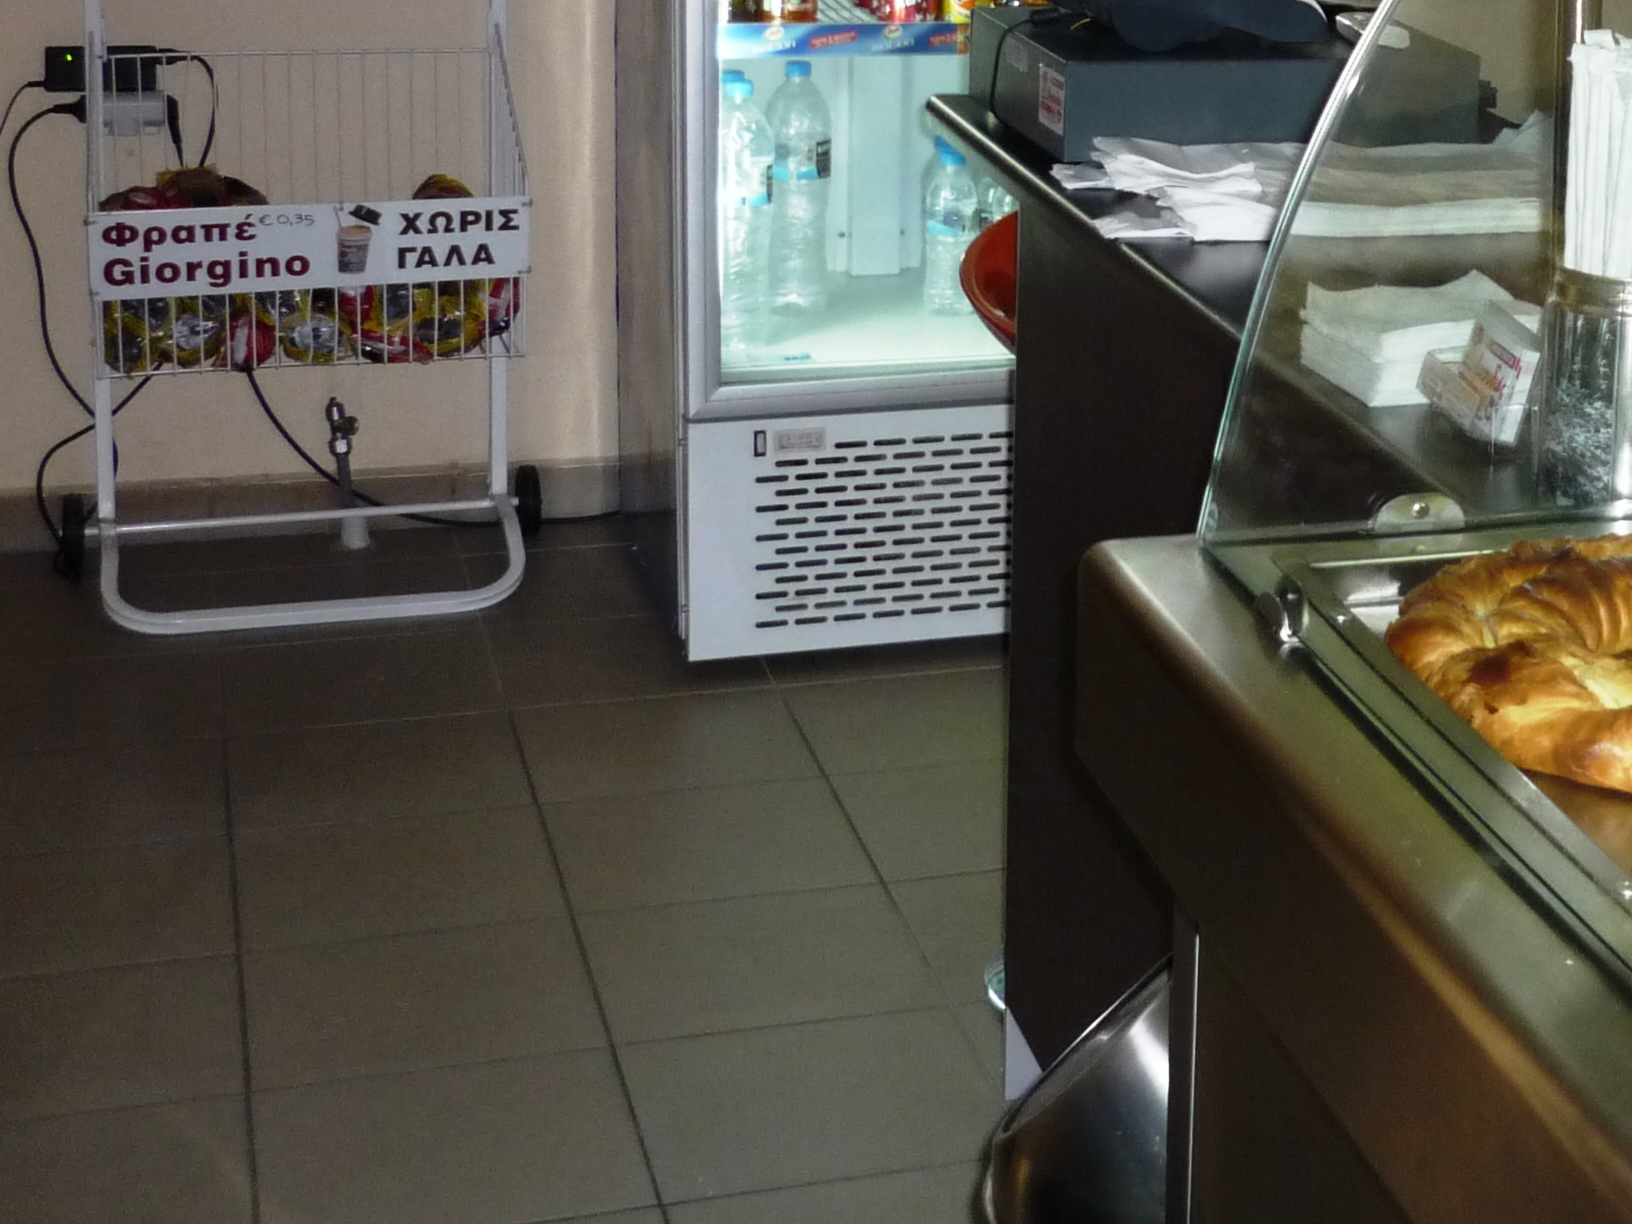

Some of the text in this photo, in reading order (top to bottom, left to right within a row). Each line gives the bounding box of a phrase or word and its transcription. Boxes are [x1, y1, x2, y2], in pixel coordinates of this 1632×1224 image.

[102, 213, 257, 253] Φραπέ
[398, 208, 520, 236] ΧΩΡΙΣ
[103, 250, 311, 288] Giorgino
[397, 242, 496, 269] ΓΑΛΑ
